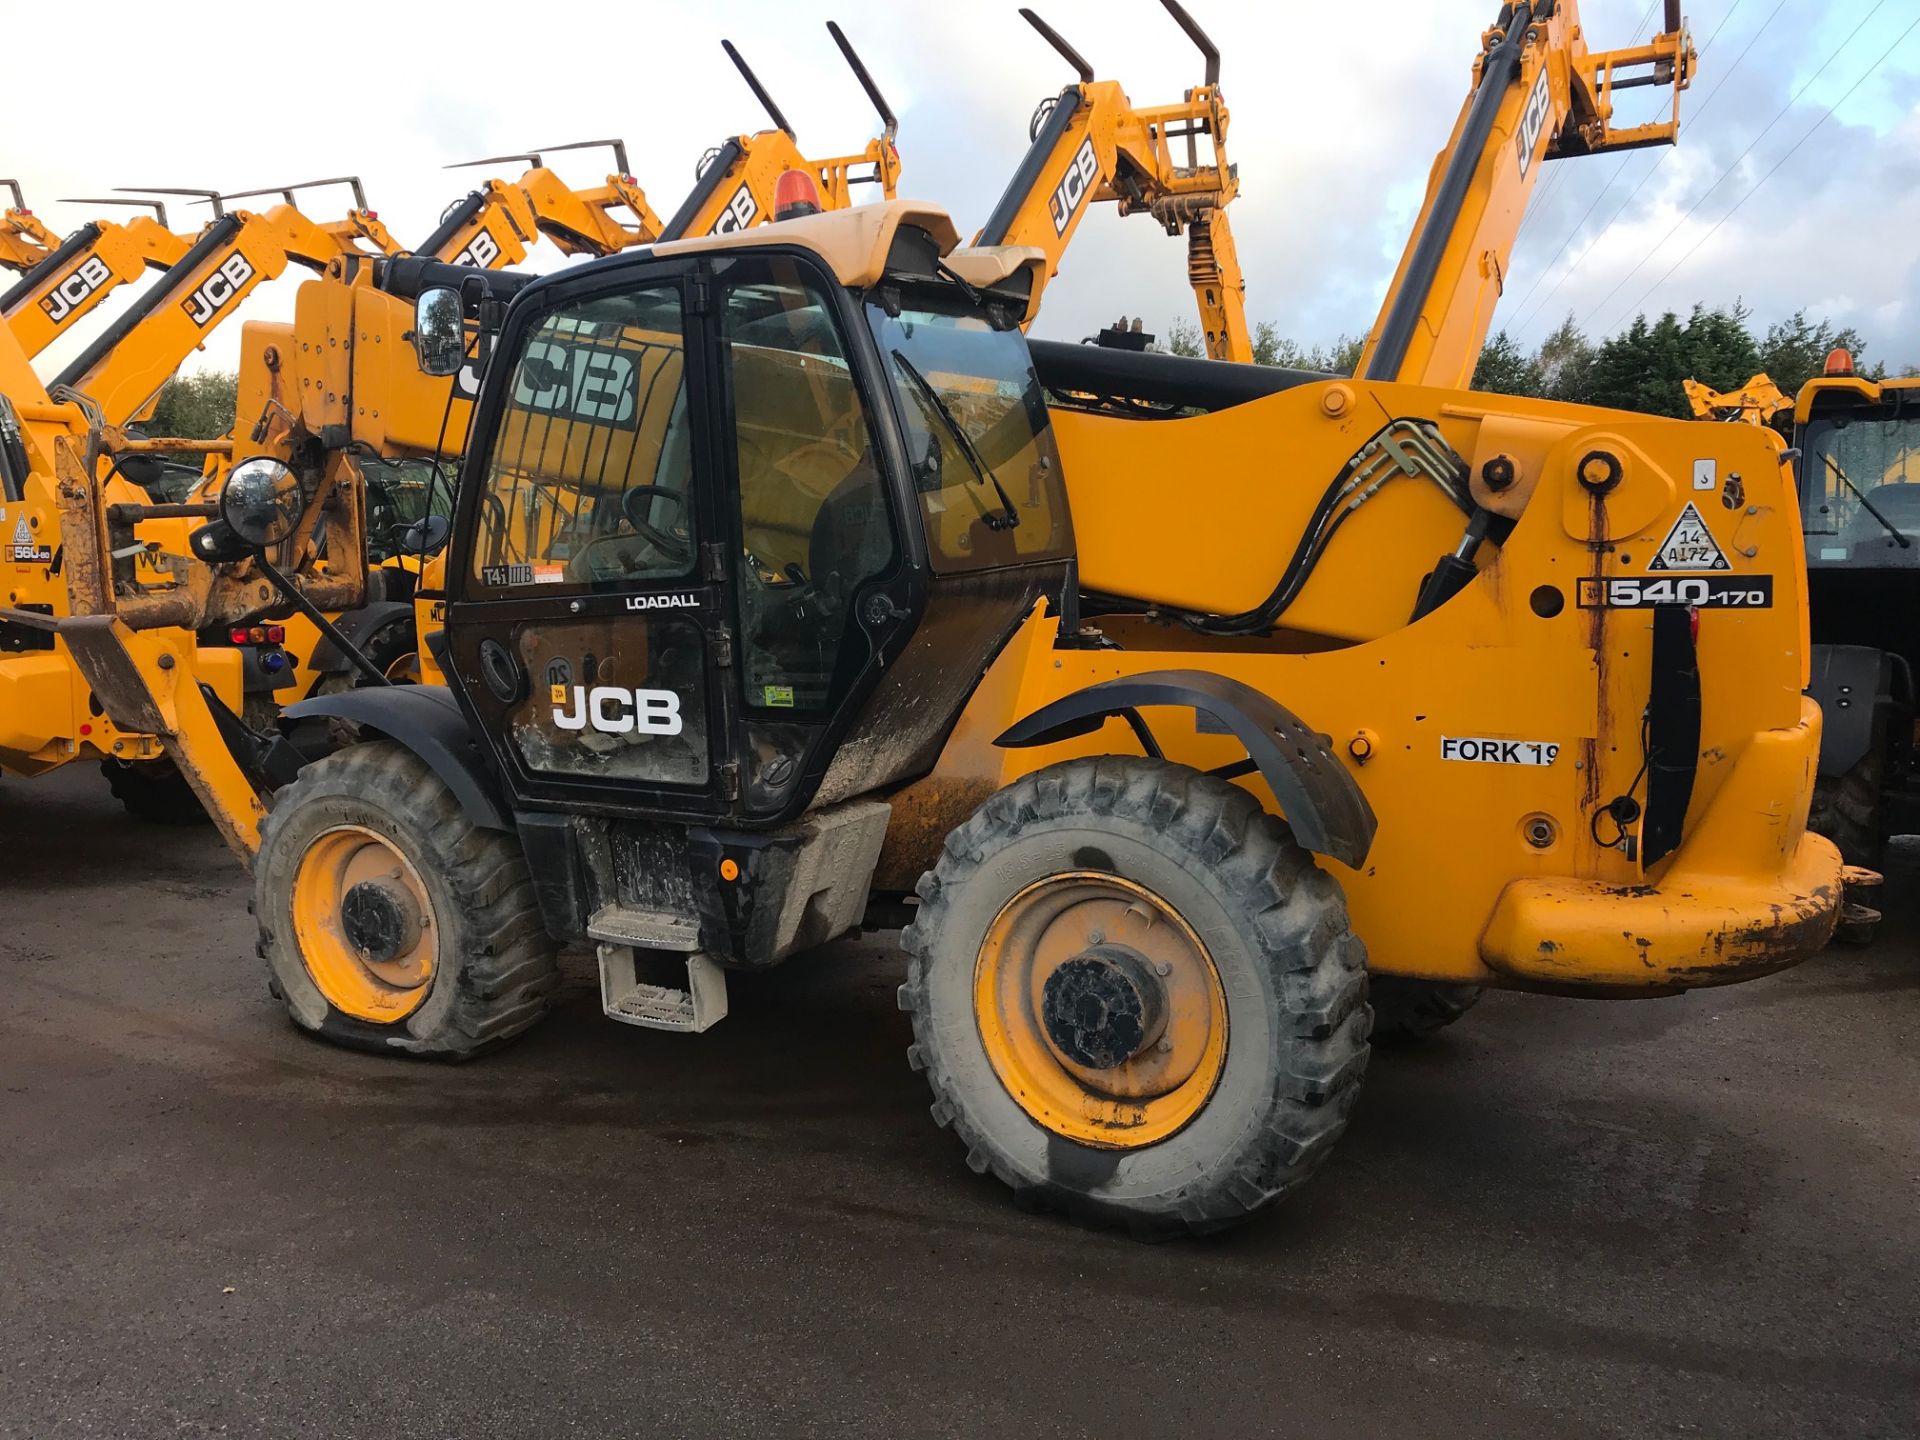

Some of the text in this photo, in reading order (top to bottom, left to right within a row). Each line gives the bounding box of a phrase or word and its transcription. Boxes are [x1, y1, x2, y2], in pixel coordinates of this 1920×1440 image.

[1520, 67, 1549, 174] JCB
[1055, 139, 1097, 232] JCB
[709, 186, 756, 237] CB
[49, 256, 111, 321] JCB
[193, 253, 252, 324] JCB
[1680, 529, 1700, 545] 14
[483, 567, 508, 586] T4i
[626, 594, 700, 610] LOADALL
[1609, 579, 1765, 606] 540-170
[552, 685, 683, 736] JCB
[1442, 739, 1521, 763] FORK
